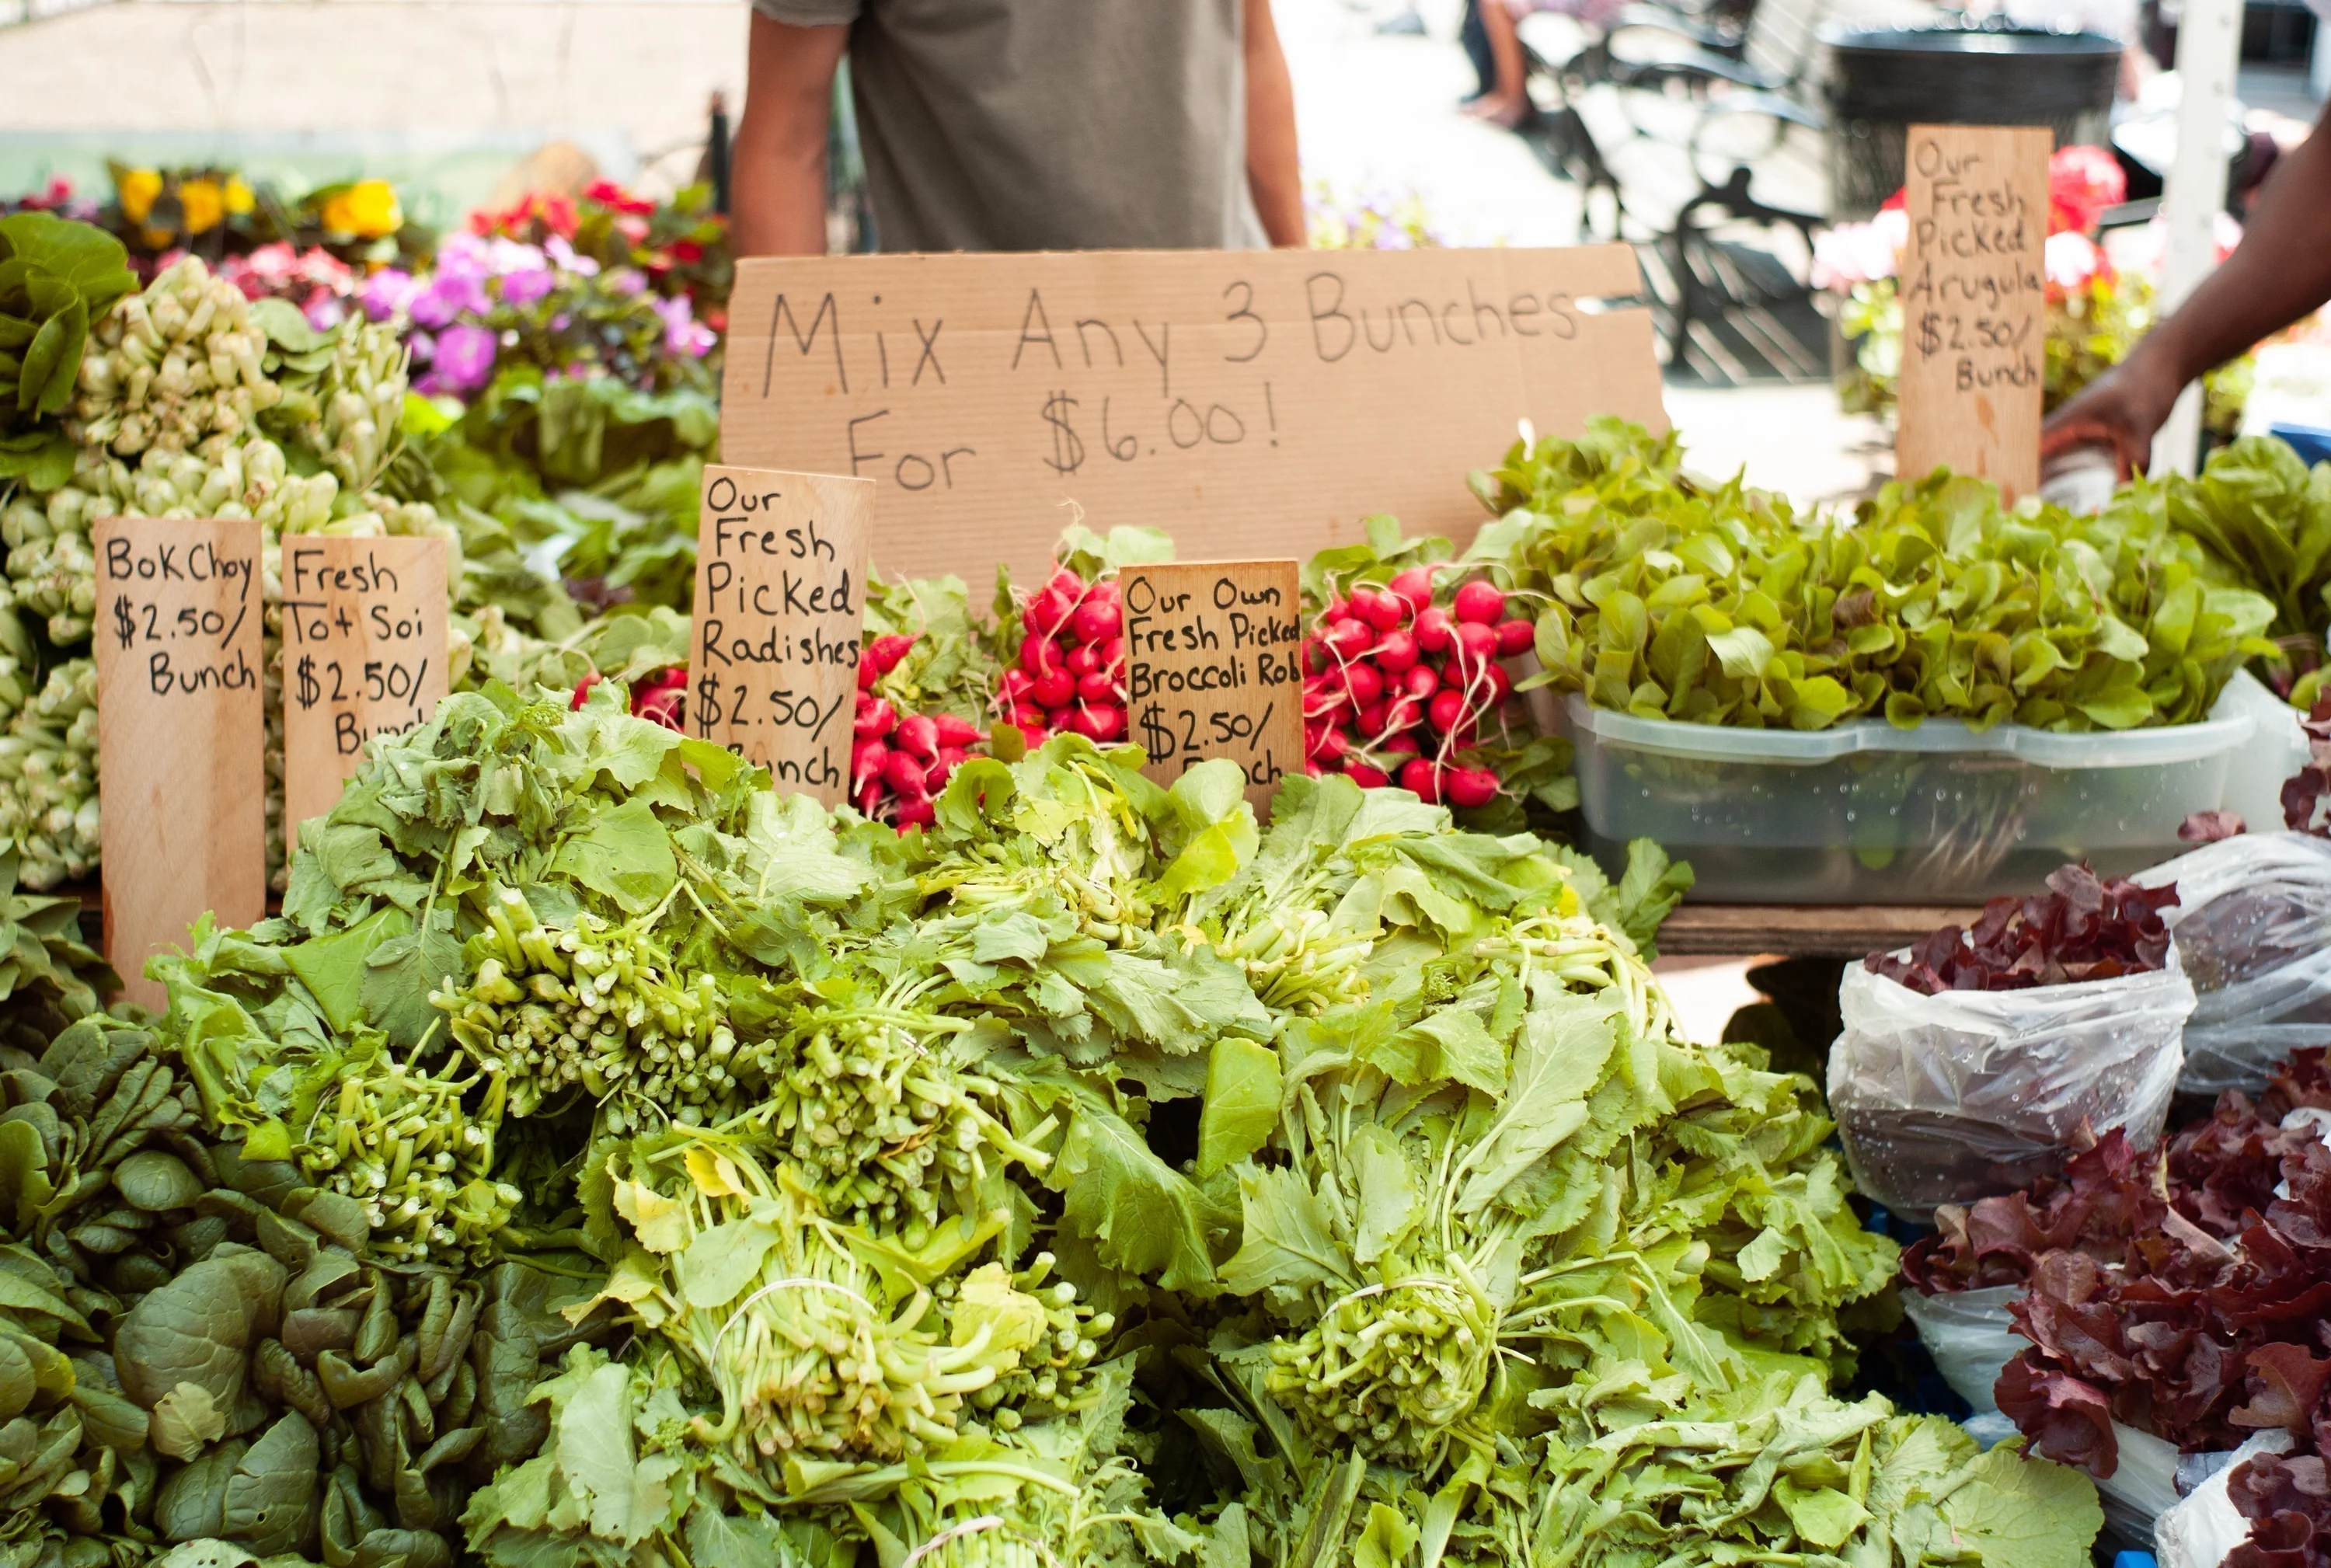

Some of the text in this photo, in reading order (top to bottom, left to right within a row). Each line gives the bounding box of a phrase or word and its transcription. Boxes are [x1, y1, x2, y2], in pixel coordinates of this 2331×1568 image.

[1915, 137, 1981, 178] Our
[1932, 177, 2027, 217] Fresh
[1916, 217, 2027, 258] Picked
[1908, 257, 2043, 311] Arugula
[763, 272, 1577, 399] Mix Any 3 Bunches
[1955, 353, 2040, 392] Bunch
[848, 381, 1280, 491] For $6.00!
[707, 476, 782, 513] Our
[716, 516, 835, 563] Fresh
[294, 549, 399, 594] Fresh
[706, 561, 855, 616] Picked
[1127, 576, 1281, 615] Our Own
[113, 595, 247, 650] $2.50/
[370, 605, 423, 640] Soi
[702, 619, 860, 669] Radishes
[1128, 615, 1219, 657] Fresh
[150, 650, 256, 696] Bunch
[296, 653, 428, 711] $2.50/
[1129, 655, 1247, 705] Broccoli
[694, 672, 844, 743] $2.50/
[1139, 701, 1274, 765] $2.50/
[726, 743, 840, 789] nch
